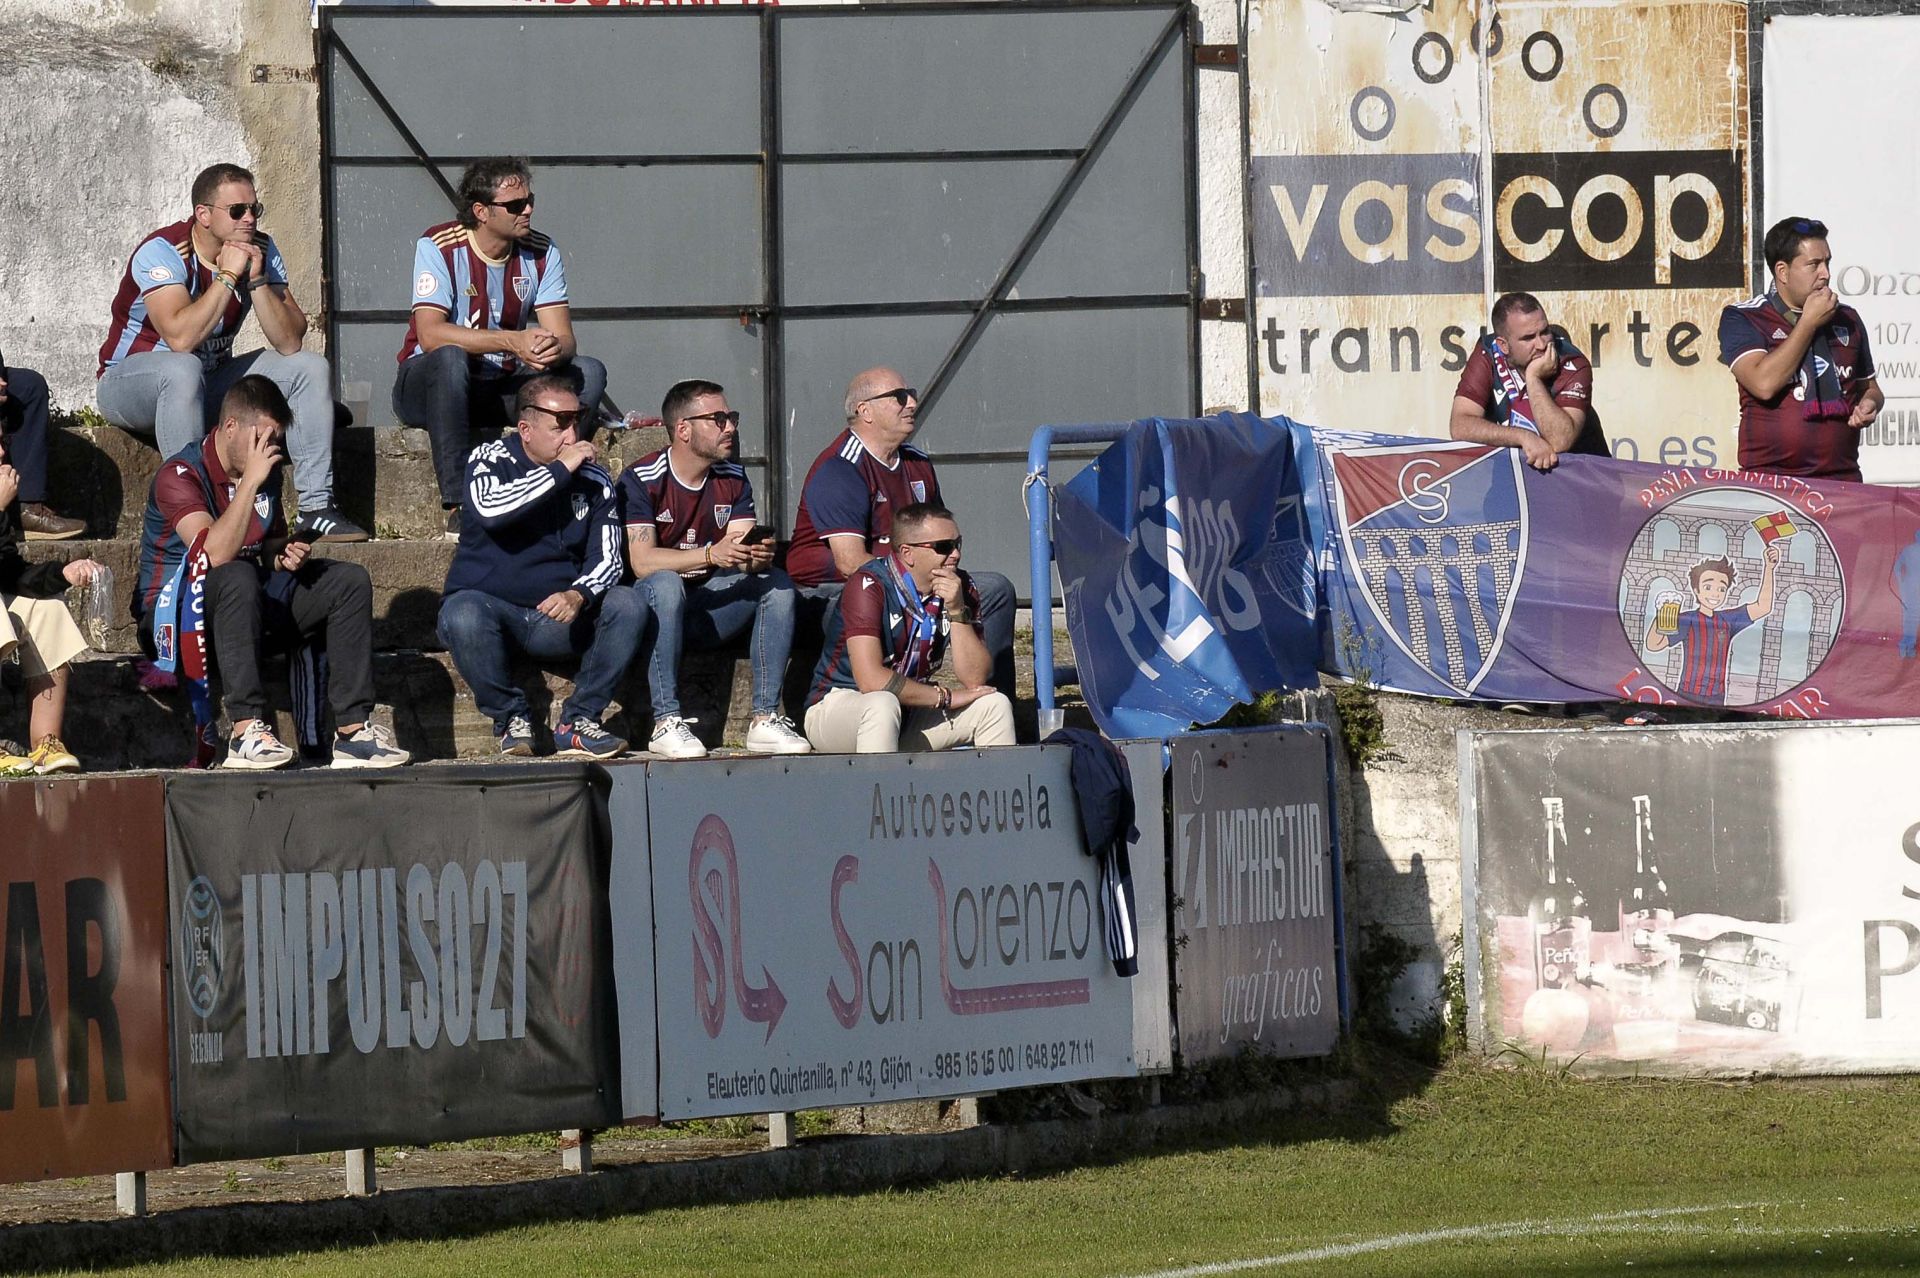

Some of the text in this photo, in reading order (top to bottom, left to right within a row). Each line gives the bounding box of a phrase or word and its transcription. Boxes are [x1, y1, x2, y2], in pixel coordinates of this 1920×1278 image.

[1270, 172, 1725, 285] vascop
[1262, 311, 1725, 375] transrte
[869, 773, 1052, 840] Autoescuela
[1216, 802, 1325, 927] IMPRASTUR
[0, 877, 127, 1111] AR
[242, 859, 528, 1059] IMPULSO27
[826, 854, 1091, 1030] San Lorenzo
[1220, 938, 1323, 1044] gráficas
[707, 1069, 767, 1100] Eleuterio
[769, 1062, 838, 1096] Quintanilla,
[880, 1055, 913, 1090] Gijón
[965, 1051, 978, 1077] 15
[981, 1049, 995, 1076] 15
[998, 1046, 1015, 1073] 00
[1069, 1039, 1082, 1065] 71
[1084, 1037, 1095, 1064] 11
